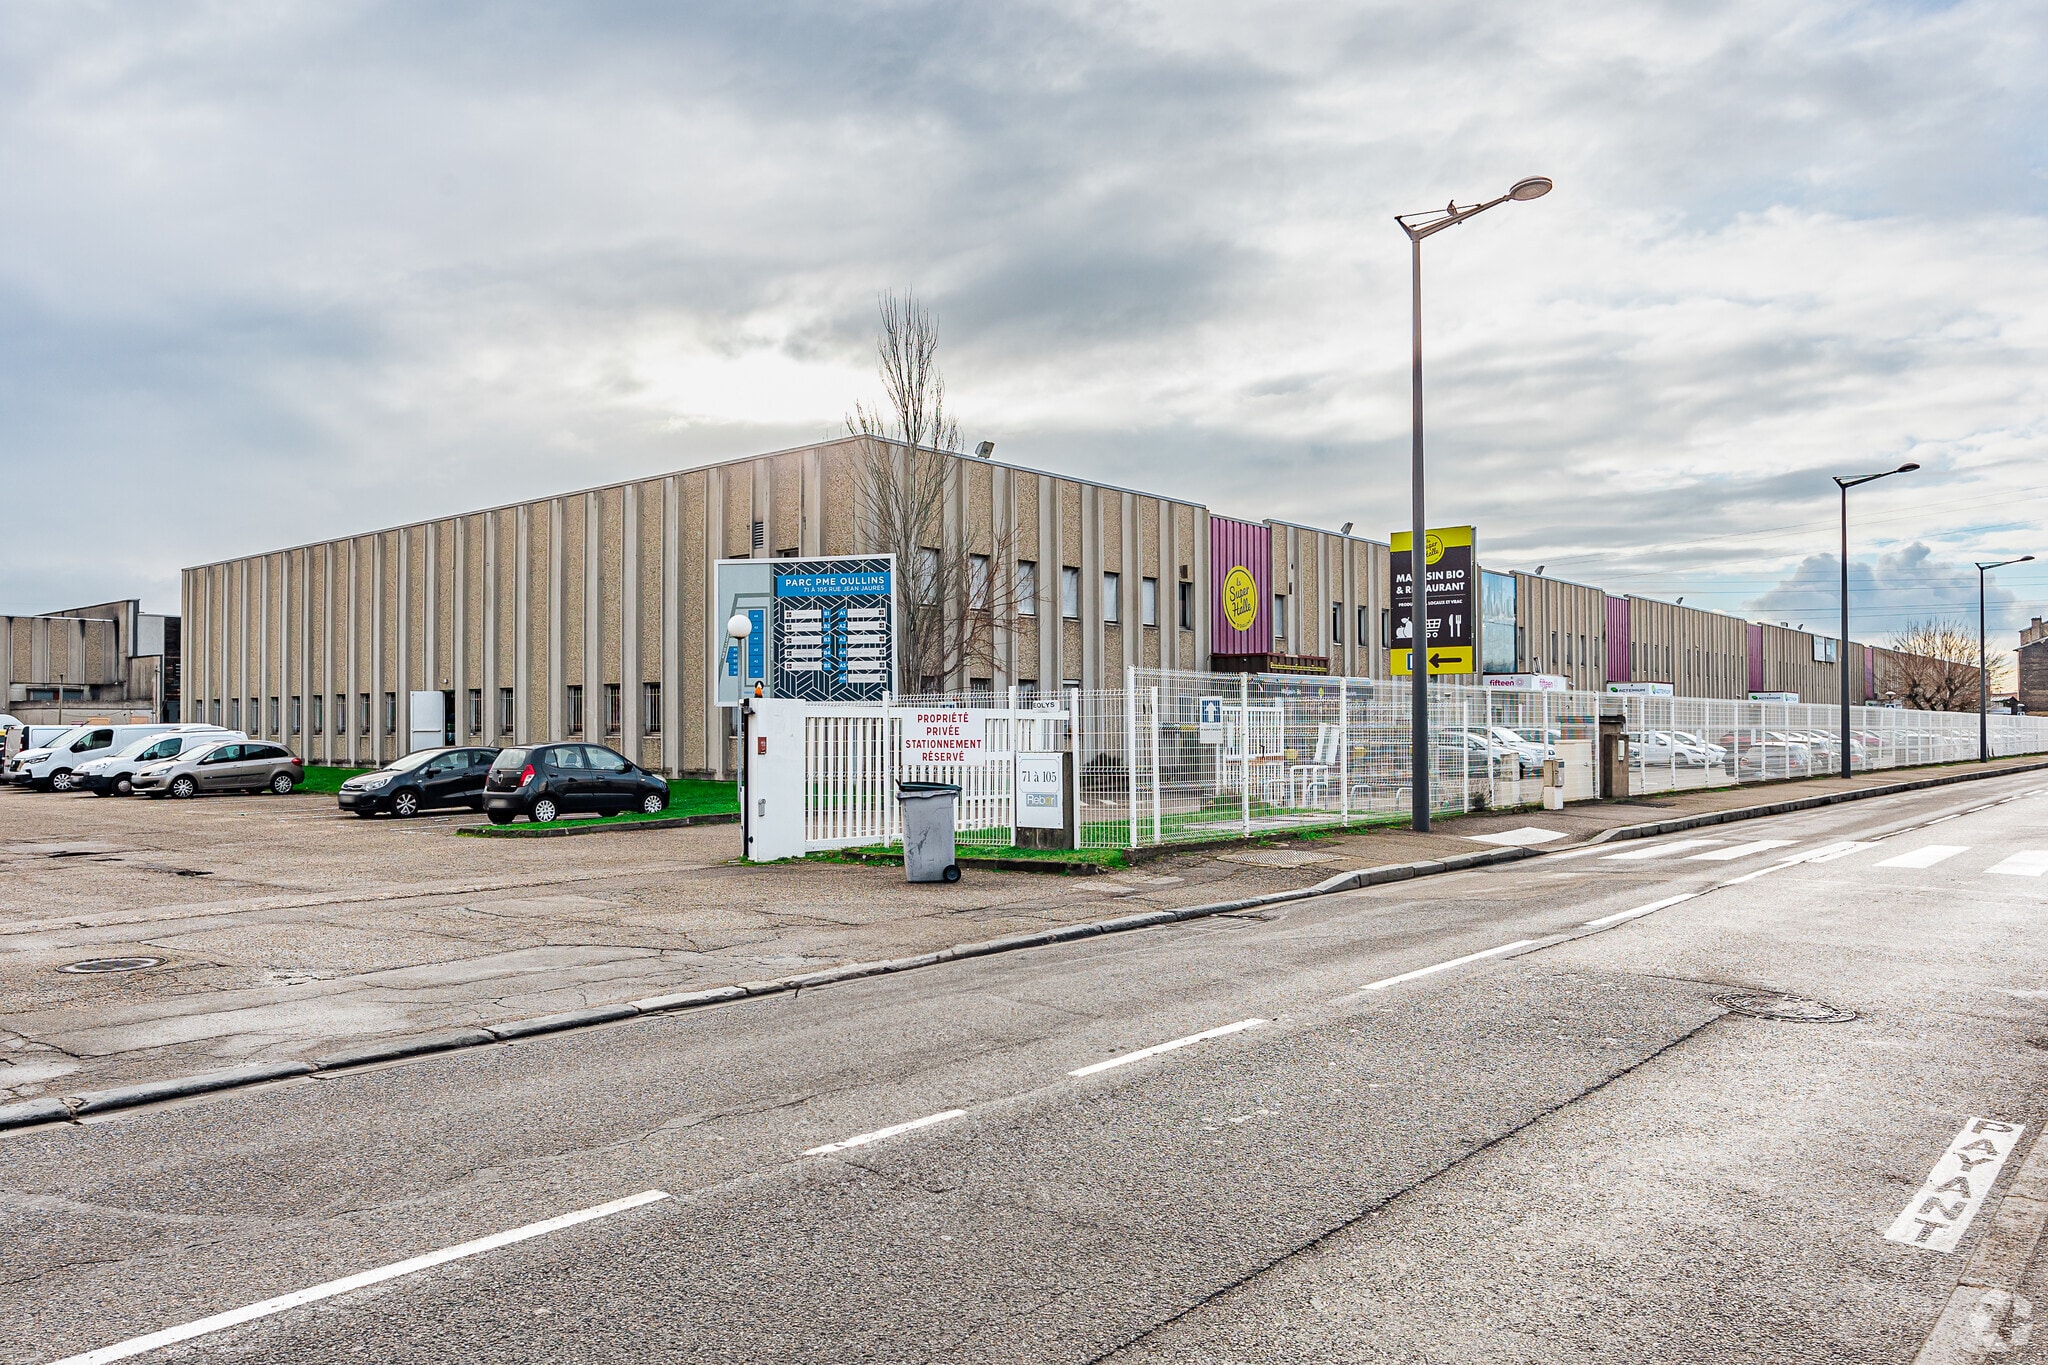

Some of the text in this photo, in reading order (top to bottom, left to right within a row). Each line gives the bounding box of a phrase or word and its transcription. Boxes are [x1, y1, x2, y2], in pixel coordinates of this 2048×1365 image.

[785, 576, 885, 587] PARC PME OULLINS
[1236, 577, 1242, 587] La
[1396, 570, 1465, 583] MASIN BIO
[828, 585, 841, 593] RUE
[1396, 582, 1465, 595] & RAURANT
[1229, 586, 1249, 604] Super
[1232, 597, 1252, 617] Halle
[1489, 679, 1515, 687] fifteen
[917, 711, 969, 723] PROPRIÉTÉ
[926, 725, 960, 736] PRIVÉE
[905, 739, 982, 749] STATIONNEMENT
[922, 750, 965, 762] RÉSERVÉ
[1022, 771, 1057, 783] 71 à 105
[1914, 1119, 2015, 1244] PAYANT
